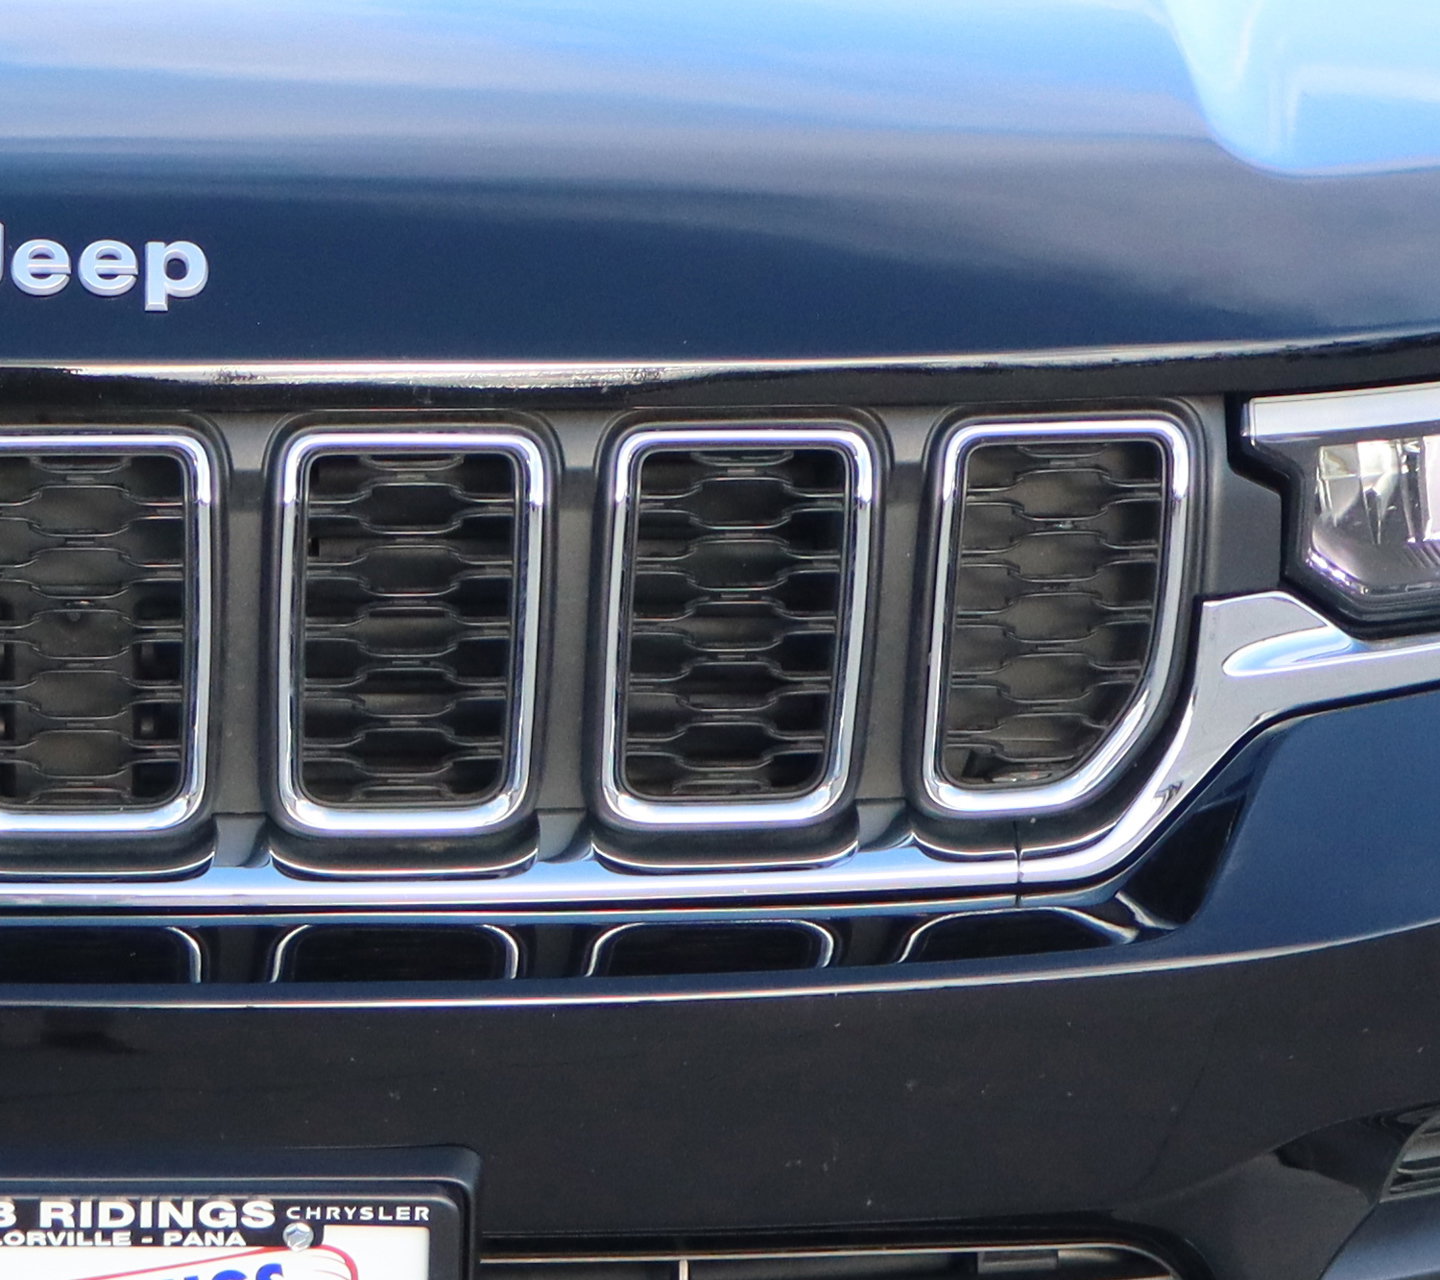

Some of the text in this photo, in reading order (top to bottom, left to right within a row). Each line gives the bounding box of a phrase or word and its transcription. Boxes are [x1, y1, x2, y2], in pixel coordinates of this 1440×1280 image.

[39, 1199, 275, 1228] RIDINGS
[286, 1206, 429, 1221] CHRYSLER
[163, 1231, 246, 1246] PANA
